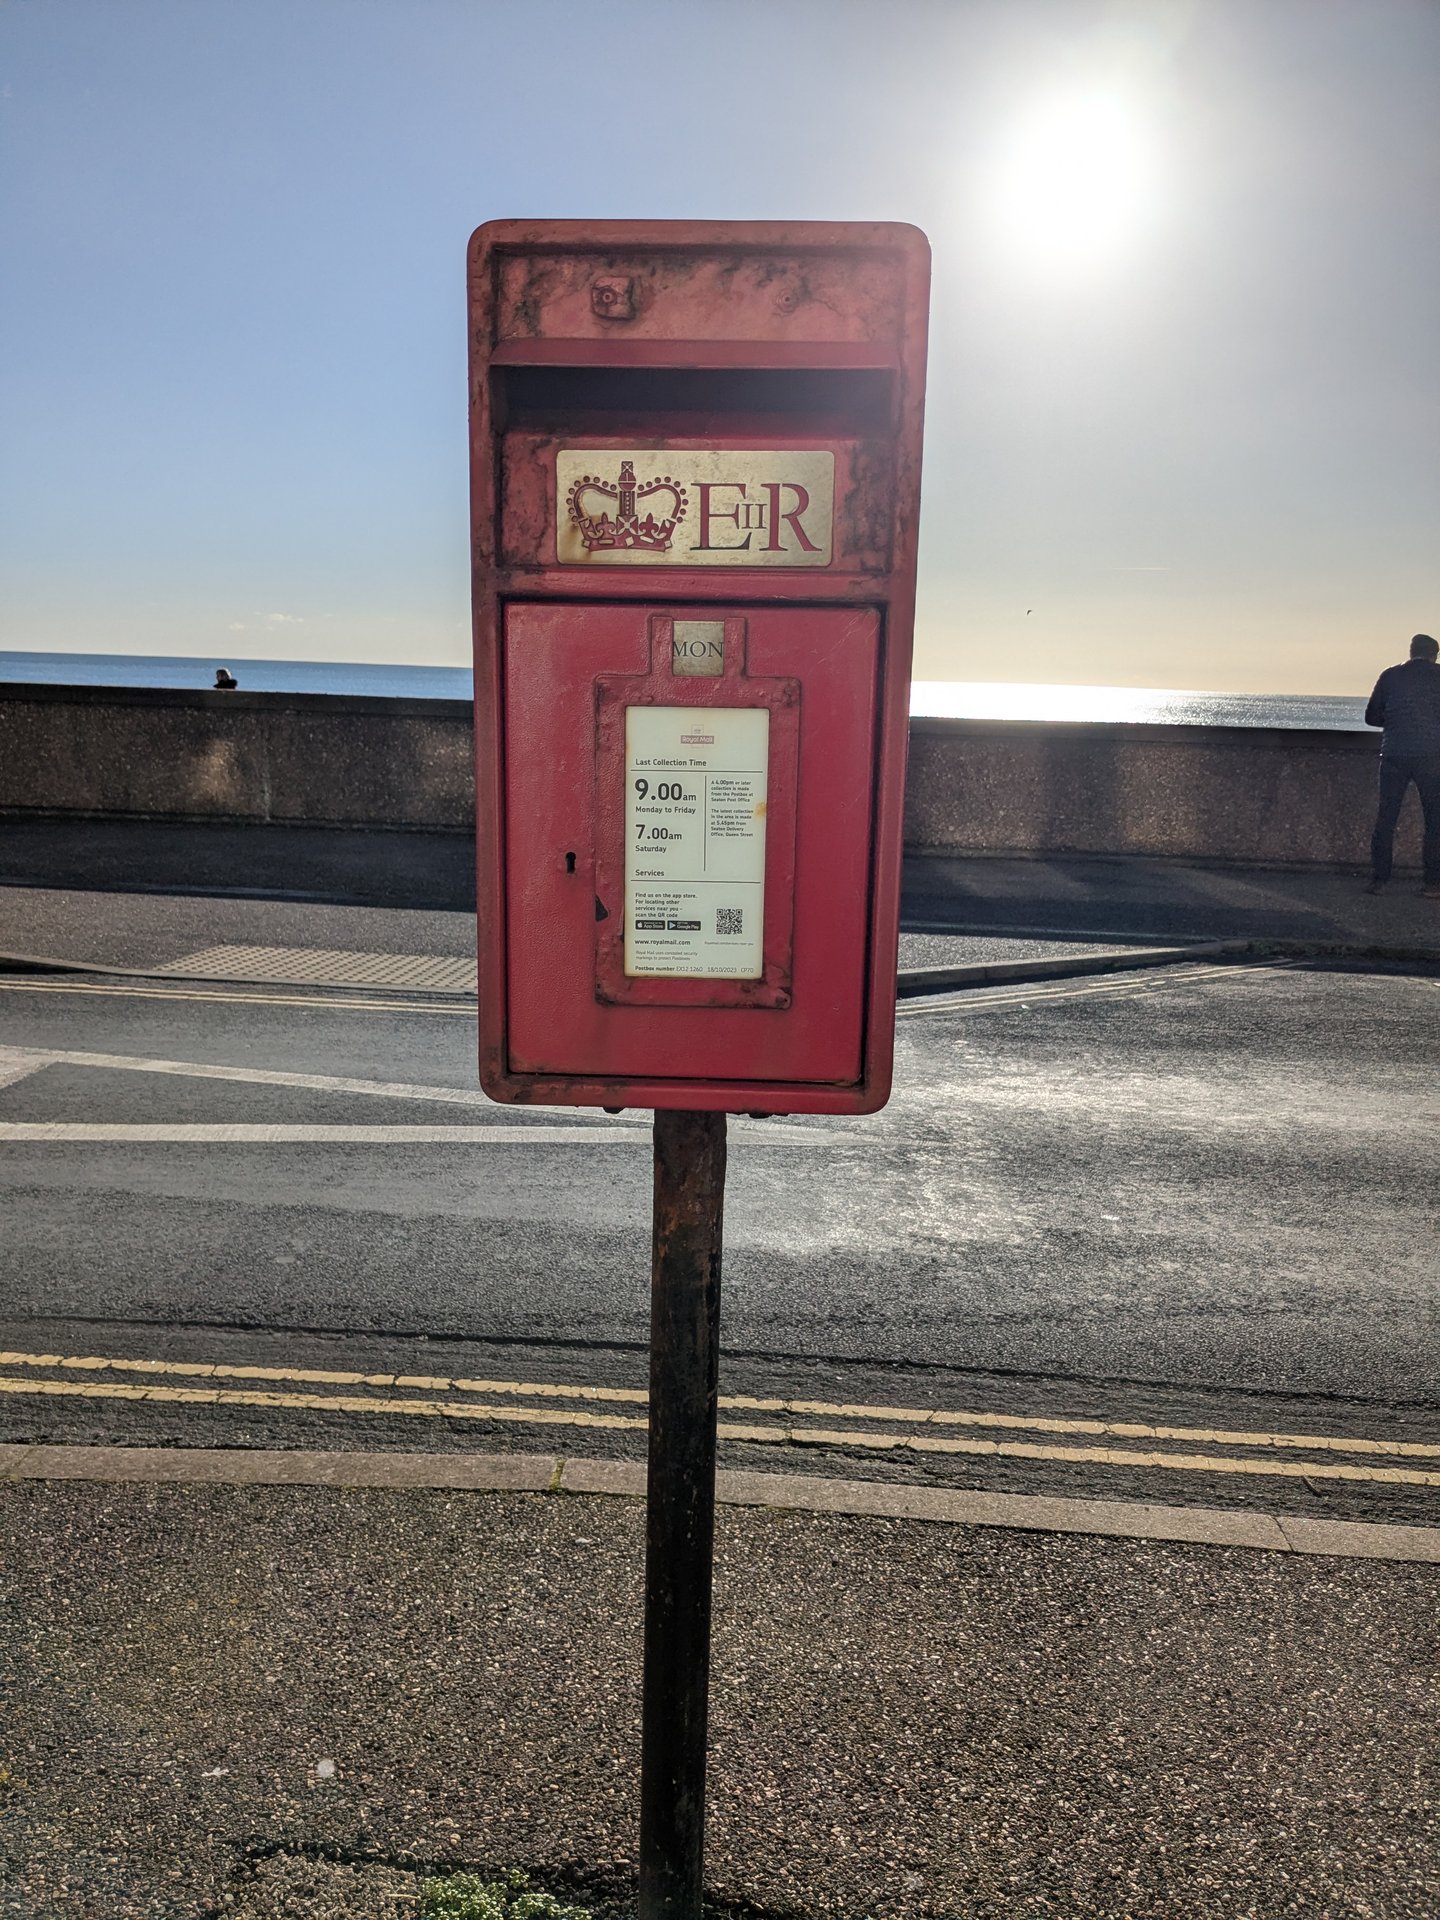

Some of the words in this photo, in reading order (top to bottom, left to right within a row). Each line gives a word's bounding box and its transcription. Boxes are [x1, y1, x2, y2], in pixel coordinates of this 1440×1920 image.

[672, 641, 724, 658] MON
[636, 806, 662, 814] Monday
[635, 845, 666, 853] Saturday
